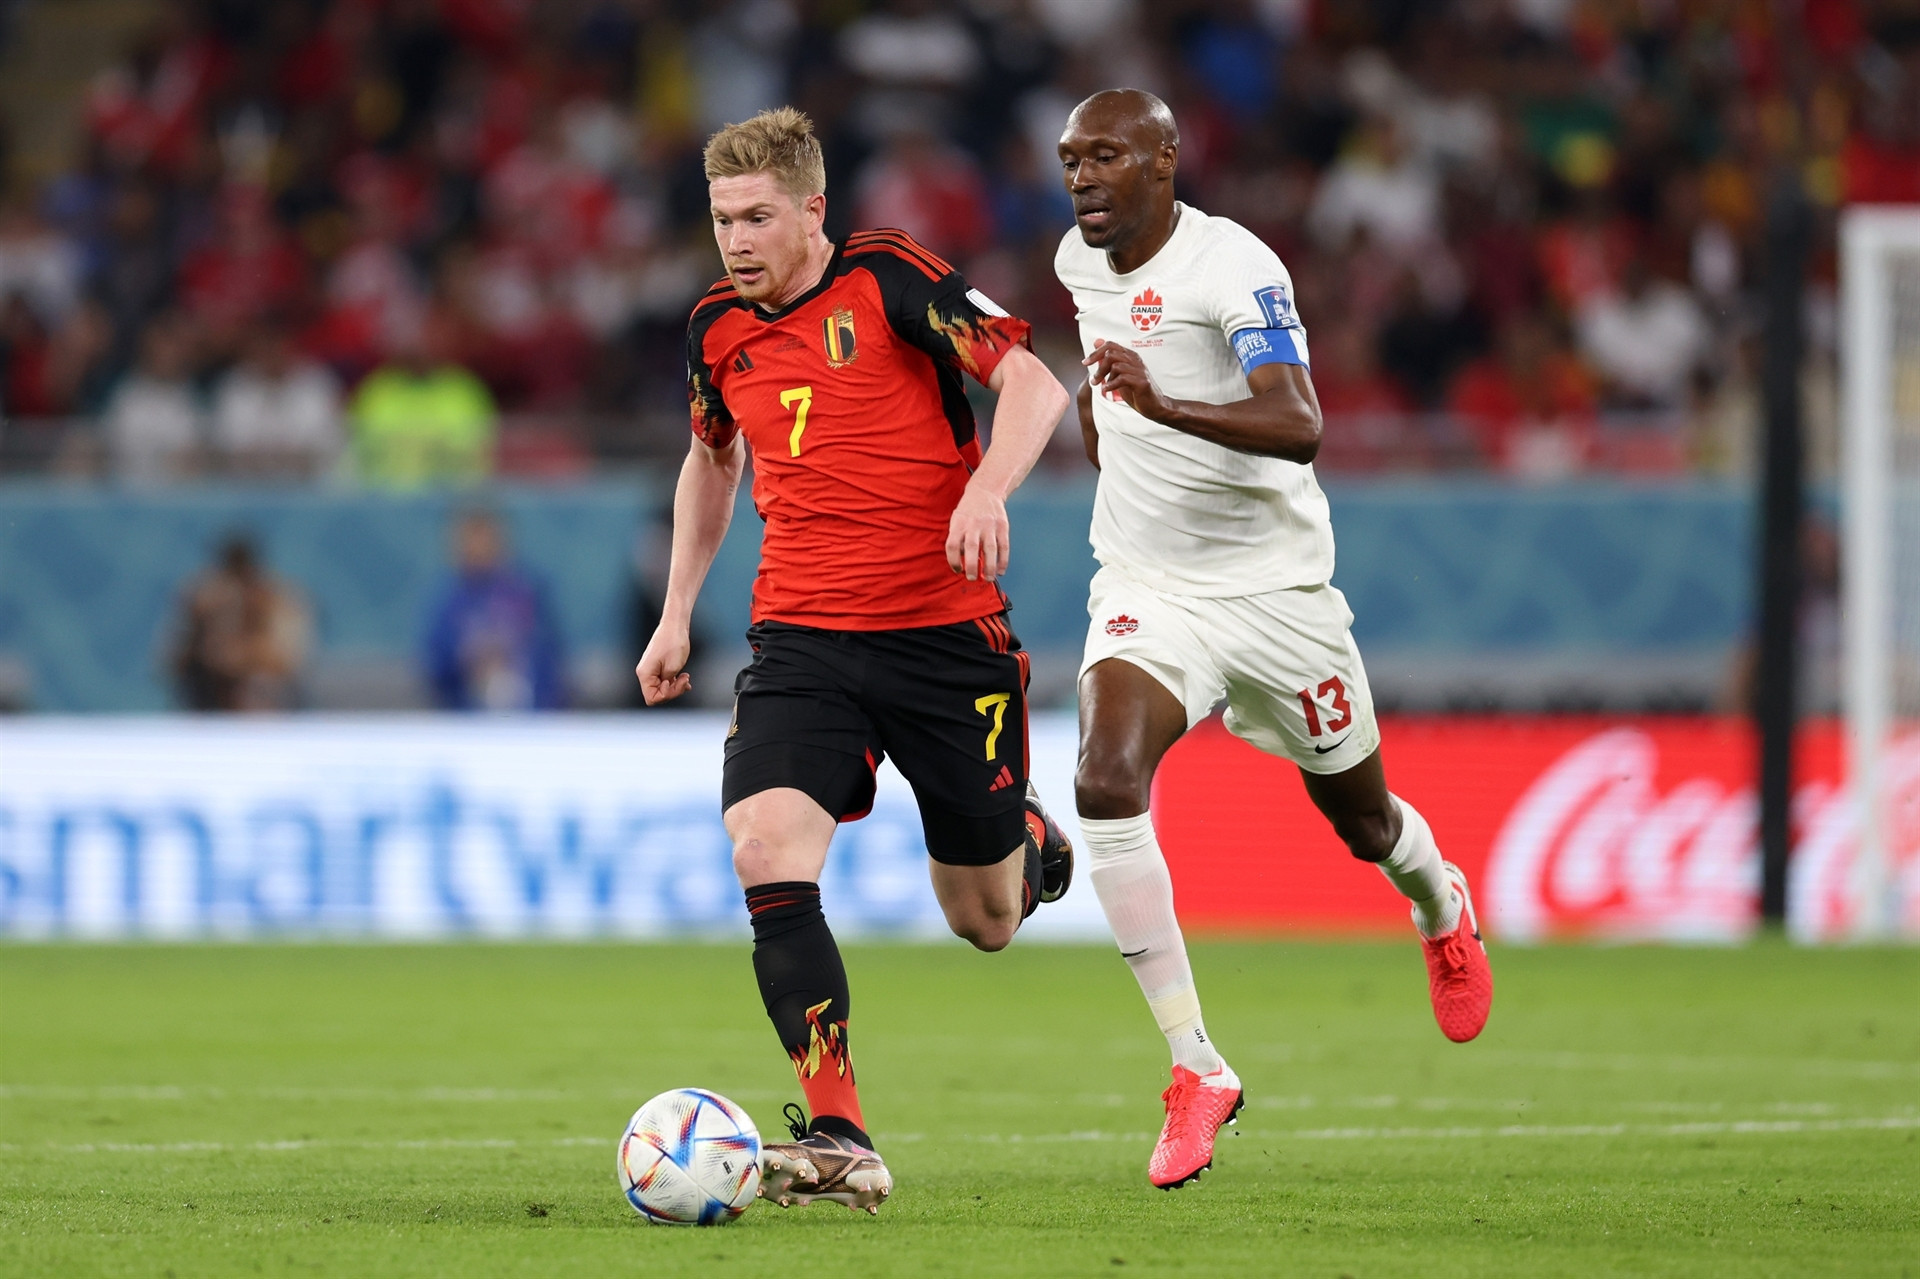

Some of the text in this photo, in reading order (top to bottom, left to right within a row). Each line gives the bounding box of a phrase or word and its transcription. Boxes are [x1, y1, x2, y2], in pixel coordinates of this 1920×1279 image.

[1131, 306, 1163, 314] CANADA
[780, 386, 812, 458] 7
[975, 692, 1011, 761] 7
[1297, 674, 1352, 737] 13
